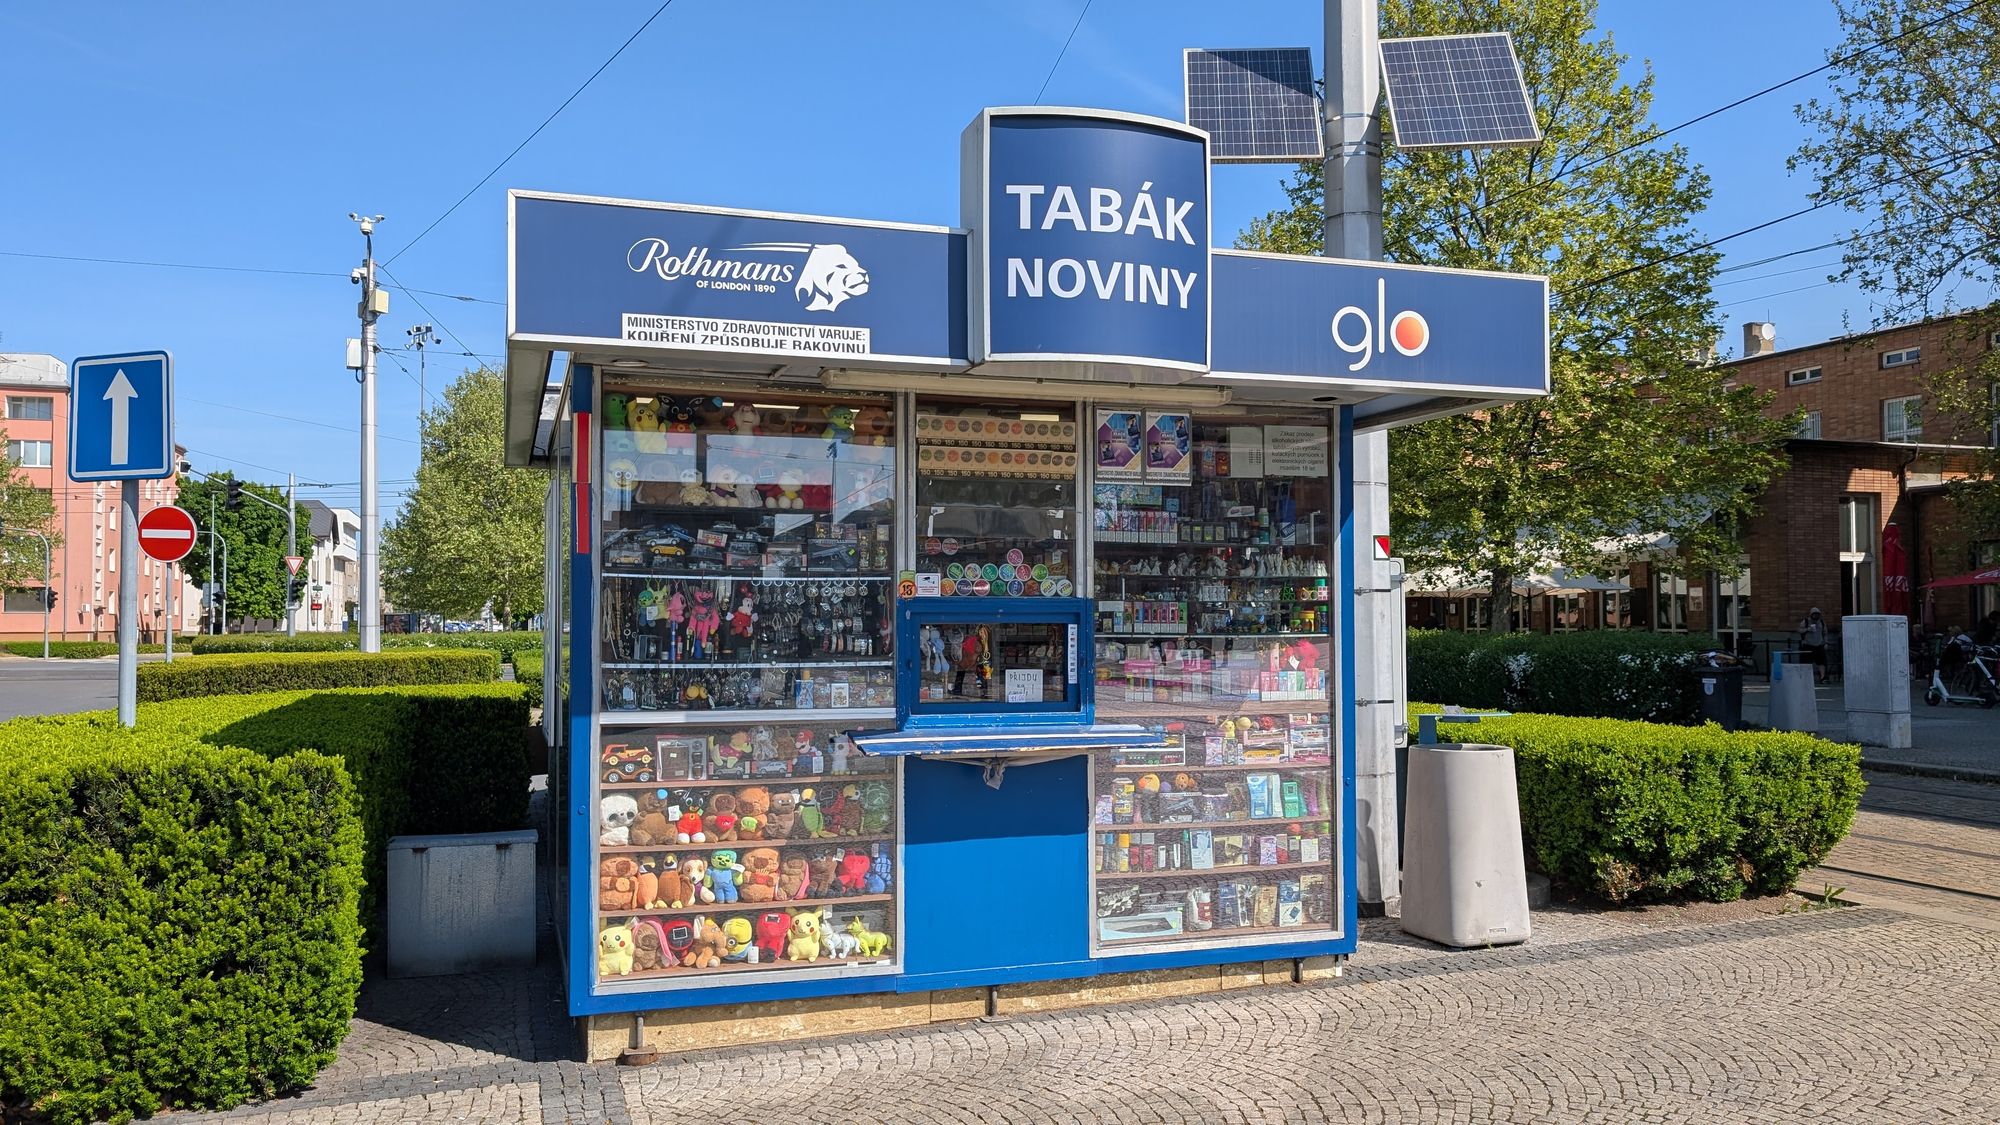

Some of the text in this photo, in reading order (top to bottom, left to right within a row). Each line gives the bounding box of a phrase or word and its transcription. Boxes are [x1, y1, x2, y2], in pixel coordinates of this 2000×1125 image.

[1005, 181, 1196, 246] TABÁK
[627, 238, 794, 282] Rothmans
[696, 280, 776, 294] OF LONDON 1890
[1007, 258, 1198, 309] NOVINY
[627, 316, 867, 342] MINISTERSTVO ZDRAVOTNICTVÍ VARUJE:
[627, 330, 867, 354] KOUŘENÍ ZPŮSOBUJE RAKOVINU
[1331, 277, 1430, 372] glo
[1010, 672, 1038, 682] PŘIJDU
